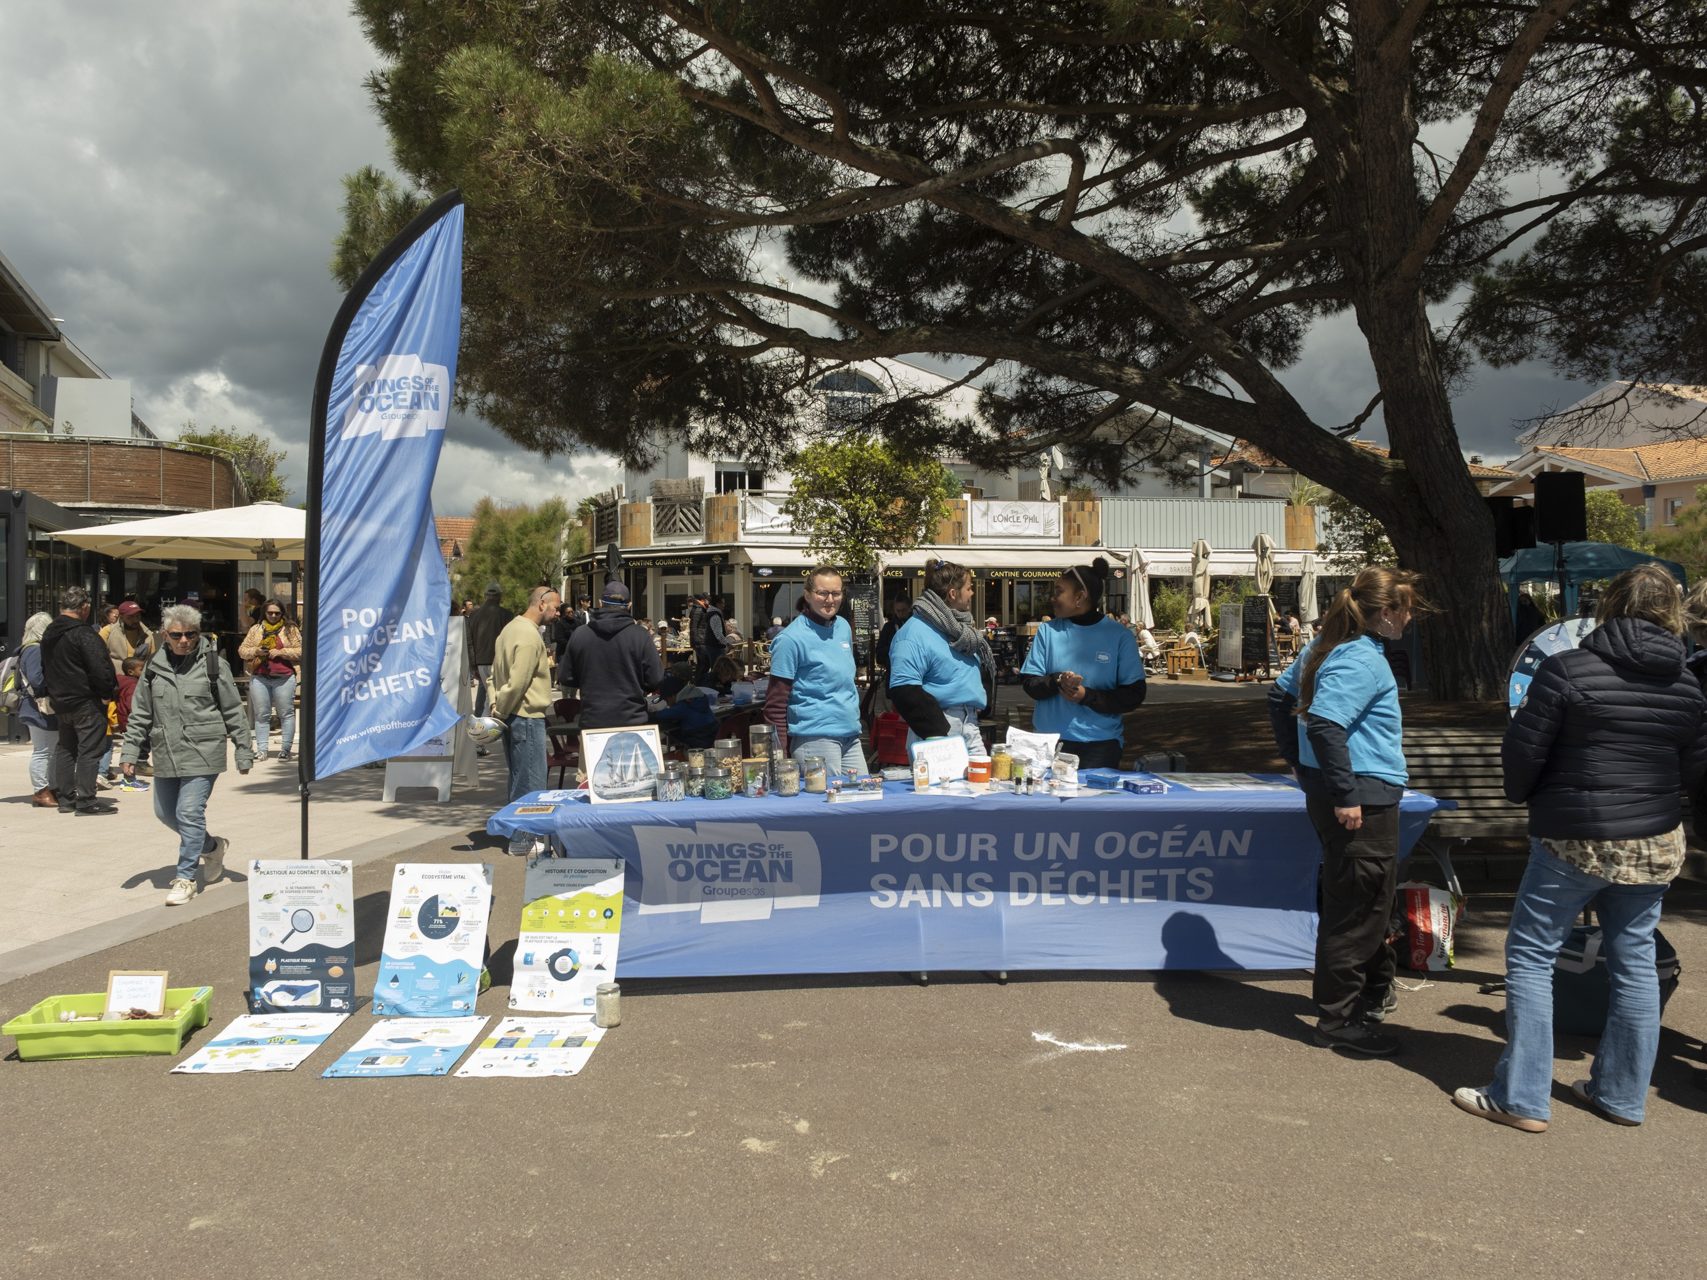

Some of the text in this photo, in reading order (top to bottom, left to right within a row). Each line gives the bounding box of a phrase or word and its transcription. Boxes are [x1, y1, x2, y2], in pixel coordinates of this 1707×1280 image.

[359, 375, 439, 396] WINGS OF THE
[358, 391, 440, 414] OCEAN
[655, 558, 694, 566] GOURMANDE
[341, 607, 384, 629] PO
[666, 842, 793, 859] WINGS OF THE
[870, 824, 1253, 863] POUR UN OCÉAN
[668, 859, 793, 883] OCEAN
[869, 862, 1214, 909] SANS DÉCHETS
